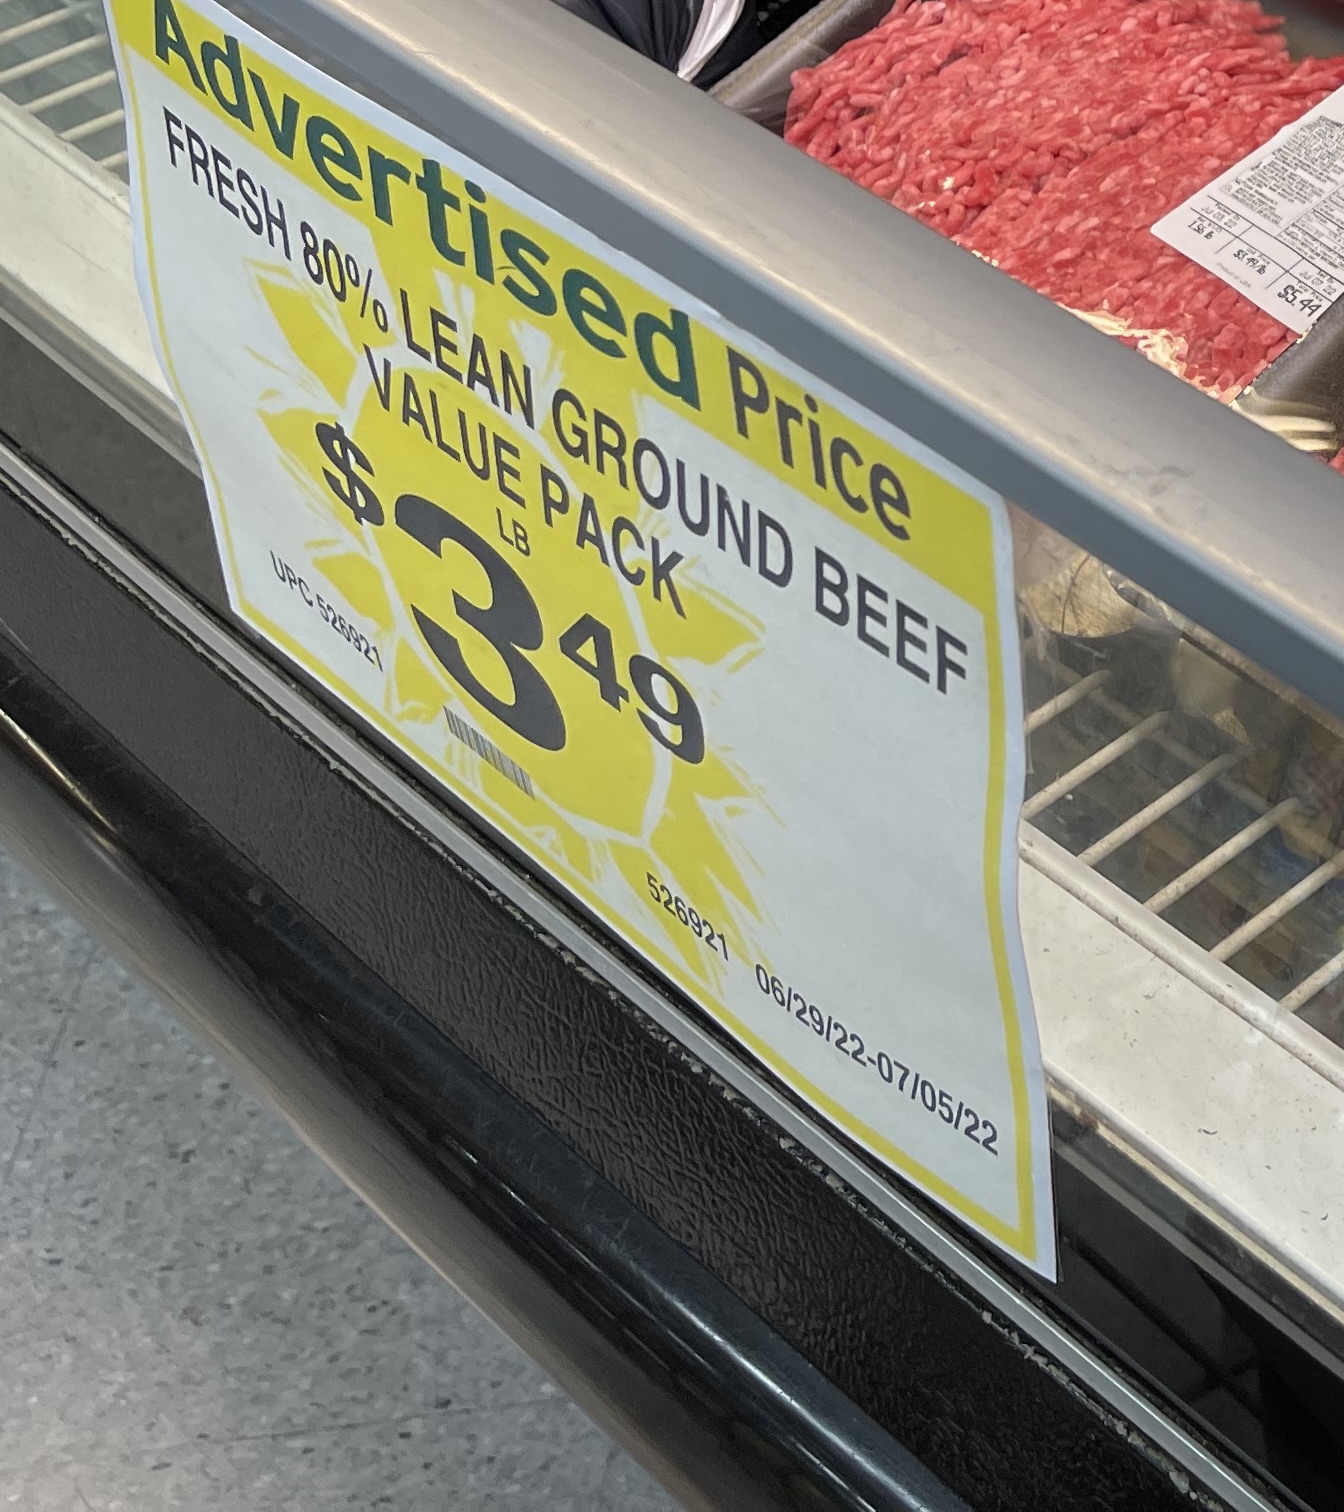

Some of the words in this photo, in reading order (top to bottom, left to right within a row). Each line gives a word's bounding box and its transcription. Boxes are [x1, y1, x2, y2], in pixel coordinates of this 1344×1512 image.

[1277, 284, 1322, 317] $5.44
[163, 106, 291, 260] FRESH
[300, 221, 389, 334] 80%
[400, 288, 535, 430] LEAN
[551, 389, 794, 588] GROUND
[814, 546, 969, 695] BEEF
[726, 345, 911, 541] Price
[363, 343, 526, 509] VALUE
[539, 463, 687, 620] PACK
[495, 507, 531, 557] LB
[269, 549, 314, 607] UPC
[315, 592, 384, 673] 526921
[645, 871, 729, 962] 526921
[755, 963, 999, 1156] 06/29/22-07/05/22
